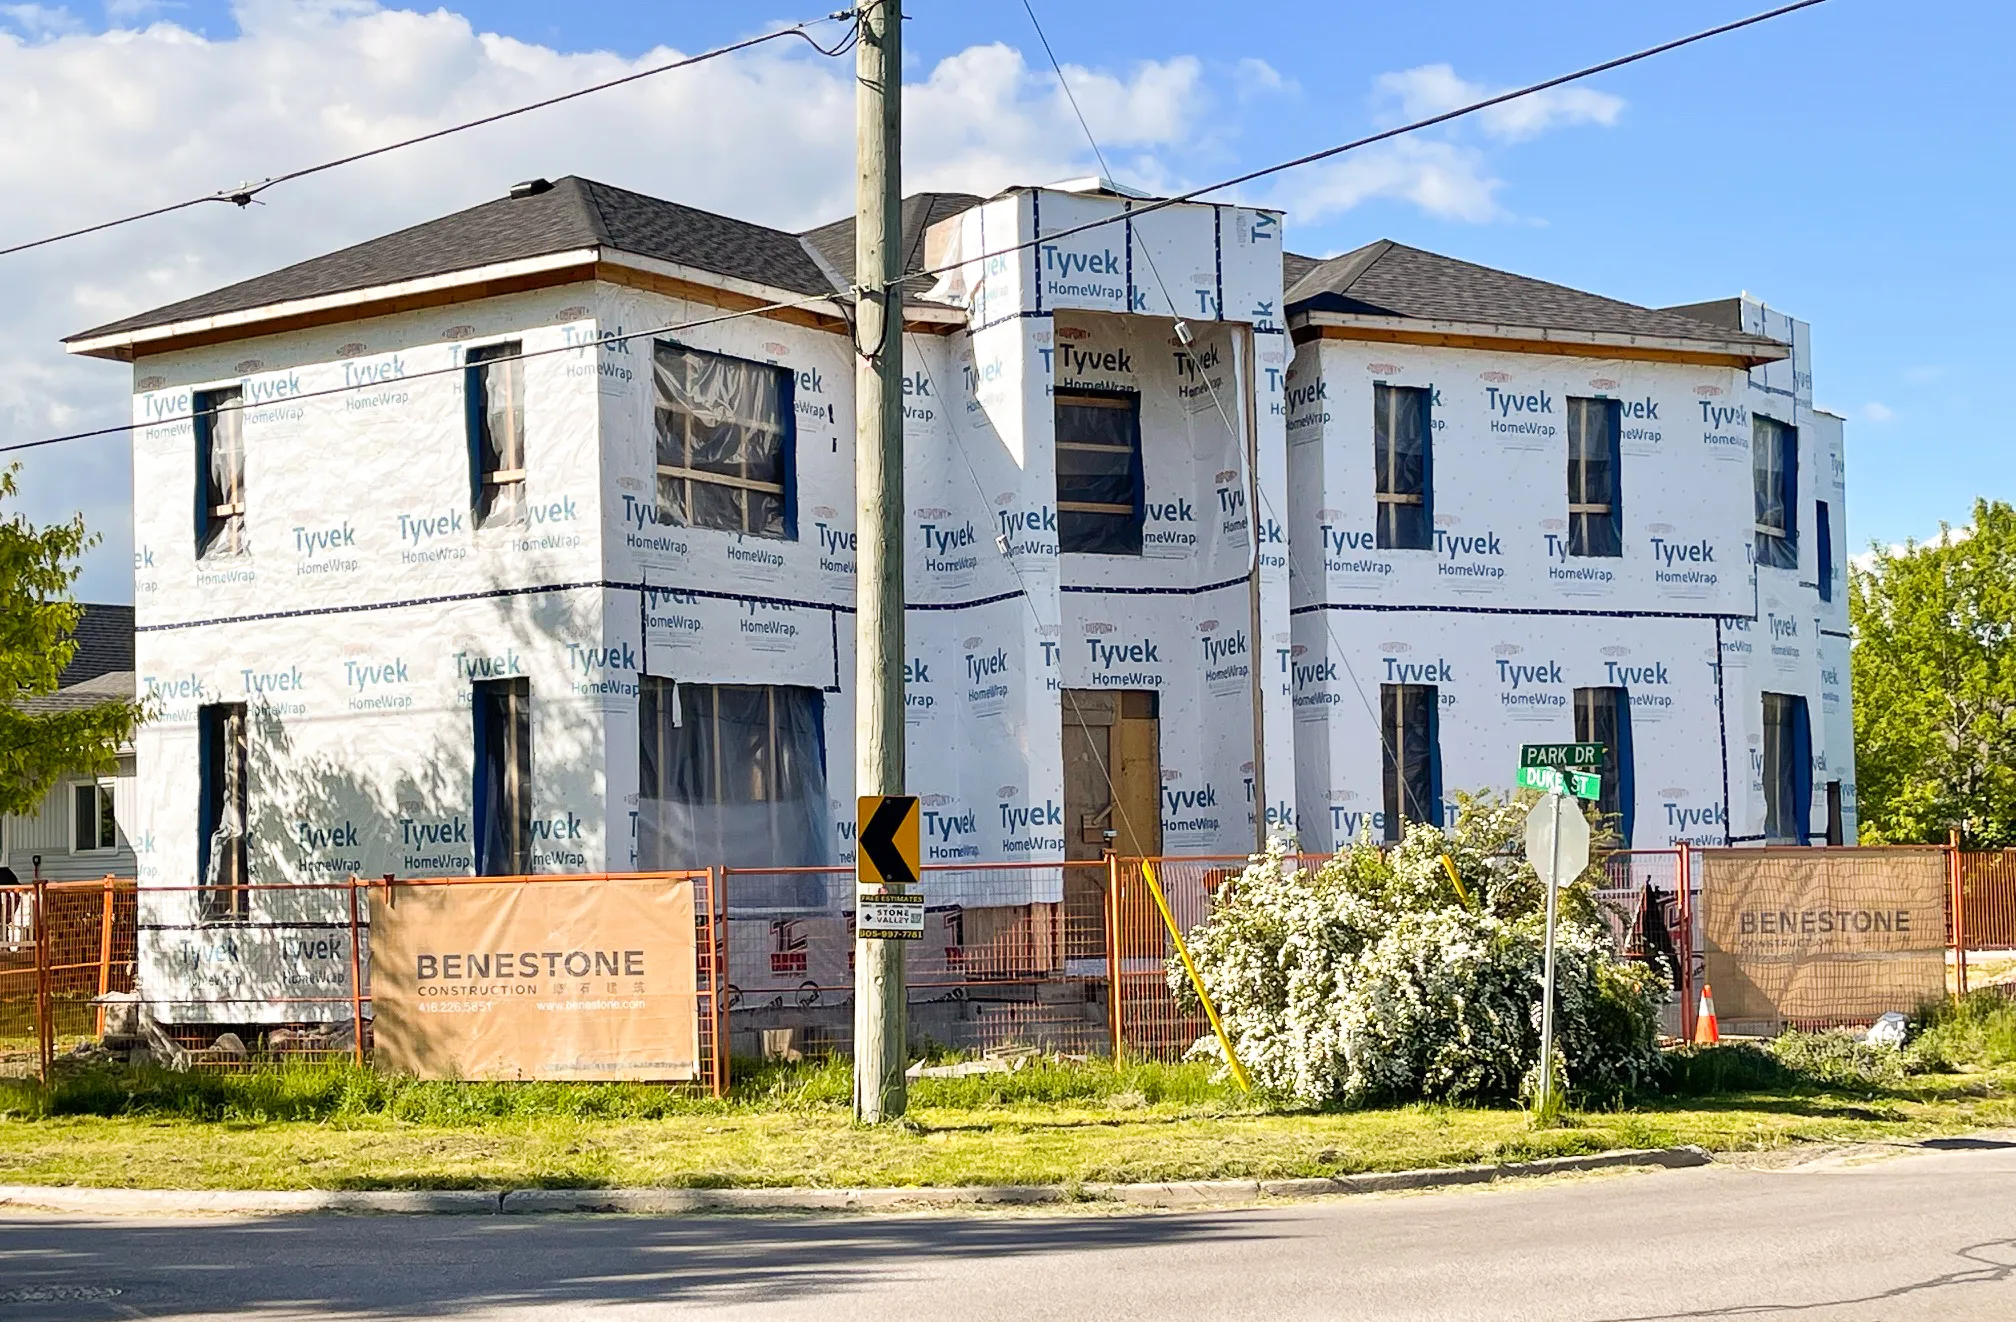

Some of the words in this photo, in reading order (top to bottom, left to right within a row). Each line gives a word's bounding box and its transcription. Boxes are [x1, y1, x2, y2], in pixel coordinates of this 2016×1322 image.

[1042, 245, 1120, 278] Tyvek
[1048, 281, 1124, 301] HomeWrap
[566, 361, 633, 383] HomeWrap
[1059, 343, 1132, 376] Tyvek
[342, 355, 405, 392] Tyvek
[346, 390, 409, 411] HomeWrap
[1486, 387, 1552, 417] Tyvek
[1699, 401, 1748, 429] Tyvek
[1491, 421, 1556, 436] HomeWrap
[397, 508, 463, 546] Tyvek
[999, 506, 1056, 537] Tyvek
[292, 521, 356, 558] Tyvek
[512, 533, 581, 552] HomeWrap
[626, 533, 689, 556] HomeWrap
[815, 522, 857, 551] Tyve
[920, 521, 976, 555] Tyvek
[1320, 525, 1374, 555] Tyve
[1434, 531, 1501, 559] Tyvek
[401, 546, 467, 565] HomeWrap
[727, 546, 784, 568] HomeWrap
[926, 556, 977, 572] HomeWrap
[1651, 537, 1714, 568] Tyvek
[196, 571, 255, 587] HomeWrap
[297, 558, 358, 576] HomeWrap
[1324, 560, 1392, 575] HomeWrap
[1439, 563, 1504, 578] HomeWrap
[1549, 567, 1613, 583] HomeWrap
[1656, 570, 1718, 585] HomeWrap
[740, 619, 795, 638] HomeWrap
[1768, 613, 1798, 641] Tyvek
[566, 642, 636, 676] Tyvek
[1086, 638, 1160, 669] Tyvek
[1202, 630, 1247, 665] Tyvek
[344, 658, 408, 692] Tyvek
[453, 649, 521, 680] Tyvek
[965, 648, 1008, 684] Tyvek
[1206, 665, 1248, 682] HomeWrap
[1383, 658, 1452, 683] Tyvek
[1496, 660, 1562, 689] Tyvek
[1604, 662, 1668, 687] Tyvek
[241, 666, 302, 695] Tyvek
[572, 681, 639, 698] HomeWrap
[968, 682, 1008, 702] HomeWrap
[1092, 672, 1163, 687] HomeWrap
[349, 695, 412, 711] HomeWrap
[1501, 692, 1566, 707] HomeWrap
[1527, 747, 1567, 764] PARK
[1575, 746, 1595, 763] DR
[1526, 767, 1563, 788] DUKE
[1570, 774, 1589, 794] ST
[923, 808, 976, 842] Tyvek
[1000, 800, 1062, 835] Tyvek
[1664, 803, 1727, 831] Tyvek
[296, 821, 358, 851] Tyvek
[400, 816, 467, 851] Tyvek
[1003, 836, 1065, 852] HomeWrap
[300, 858, 361, 873] HomeWrap
[404, 854, 469, 871] HomeWrap
[1741, 911, 1910, 934] BENESTONE
[417, 951, 644, 980] BENESTONE
[418, 984, 537, 996] CONSTRUCTION
[536, 1000, 645, 1011] www.benestone.com
